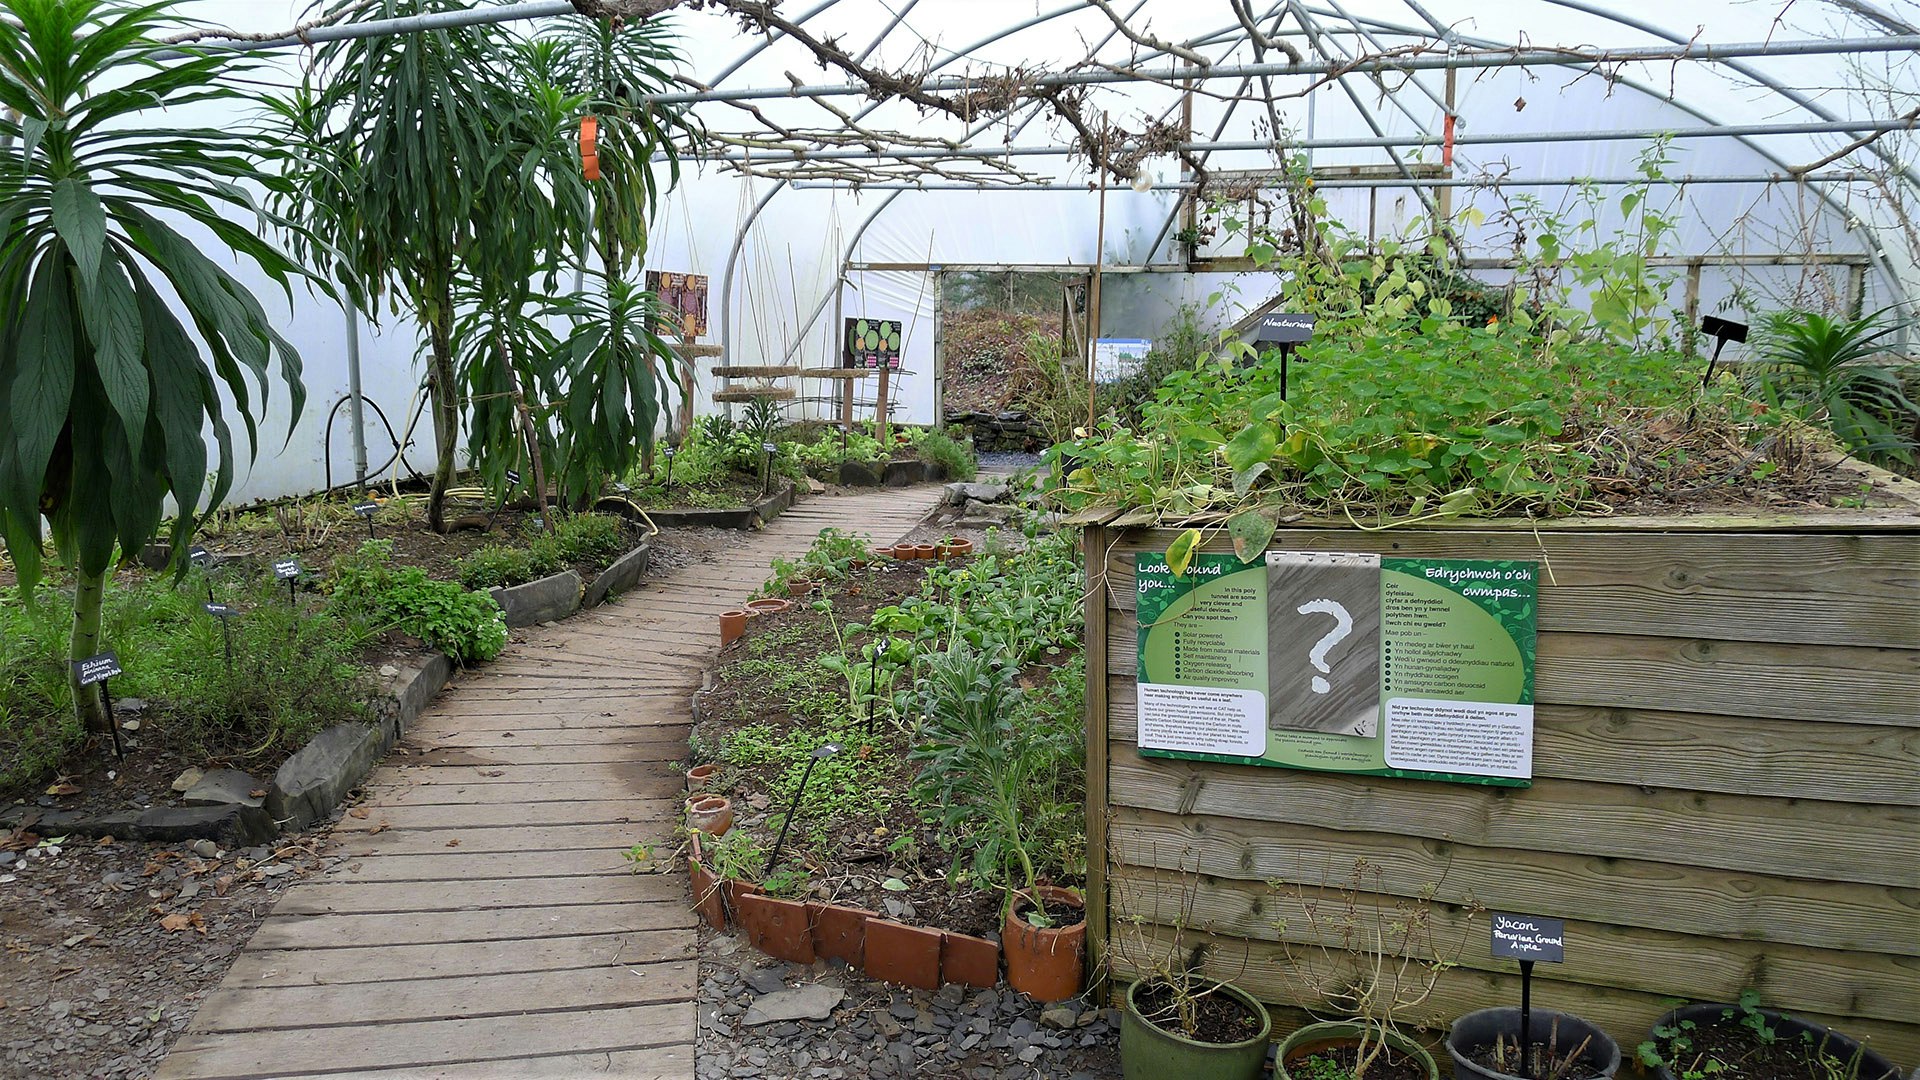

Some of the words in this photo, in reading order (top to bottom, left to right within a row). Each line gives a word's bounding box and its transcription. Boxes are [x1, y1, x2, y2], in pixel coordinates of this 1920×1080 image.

[1138, 562, 1170, 574] Look
[1186, 563, 1221, 575] ound
[1425, 566, 1502, 585] Edrychwch
[1505, 569, 1532, 581] o'ch
[1138, 579, 1176, 594] you...
[1462, 587, 1531, 602] cwmpas...
[1496, 916, 1539, 931] Yacon
[1535, 934, 1563, 946] Ground
